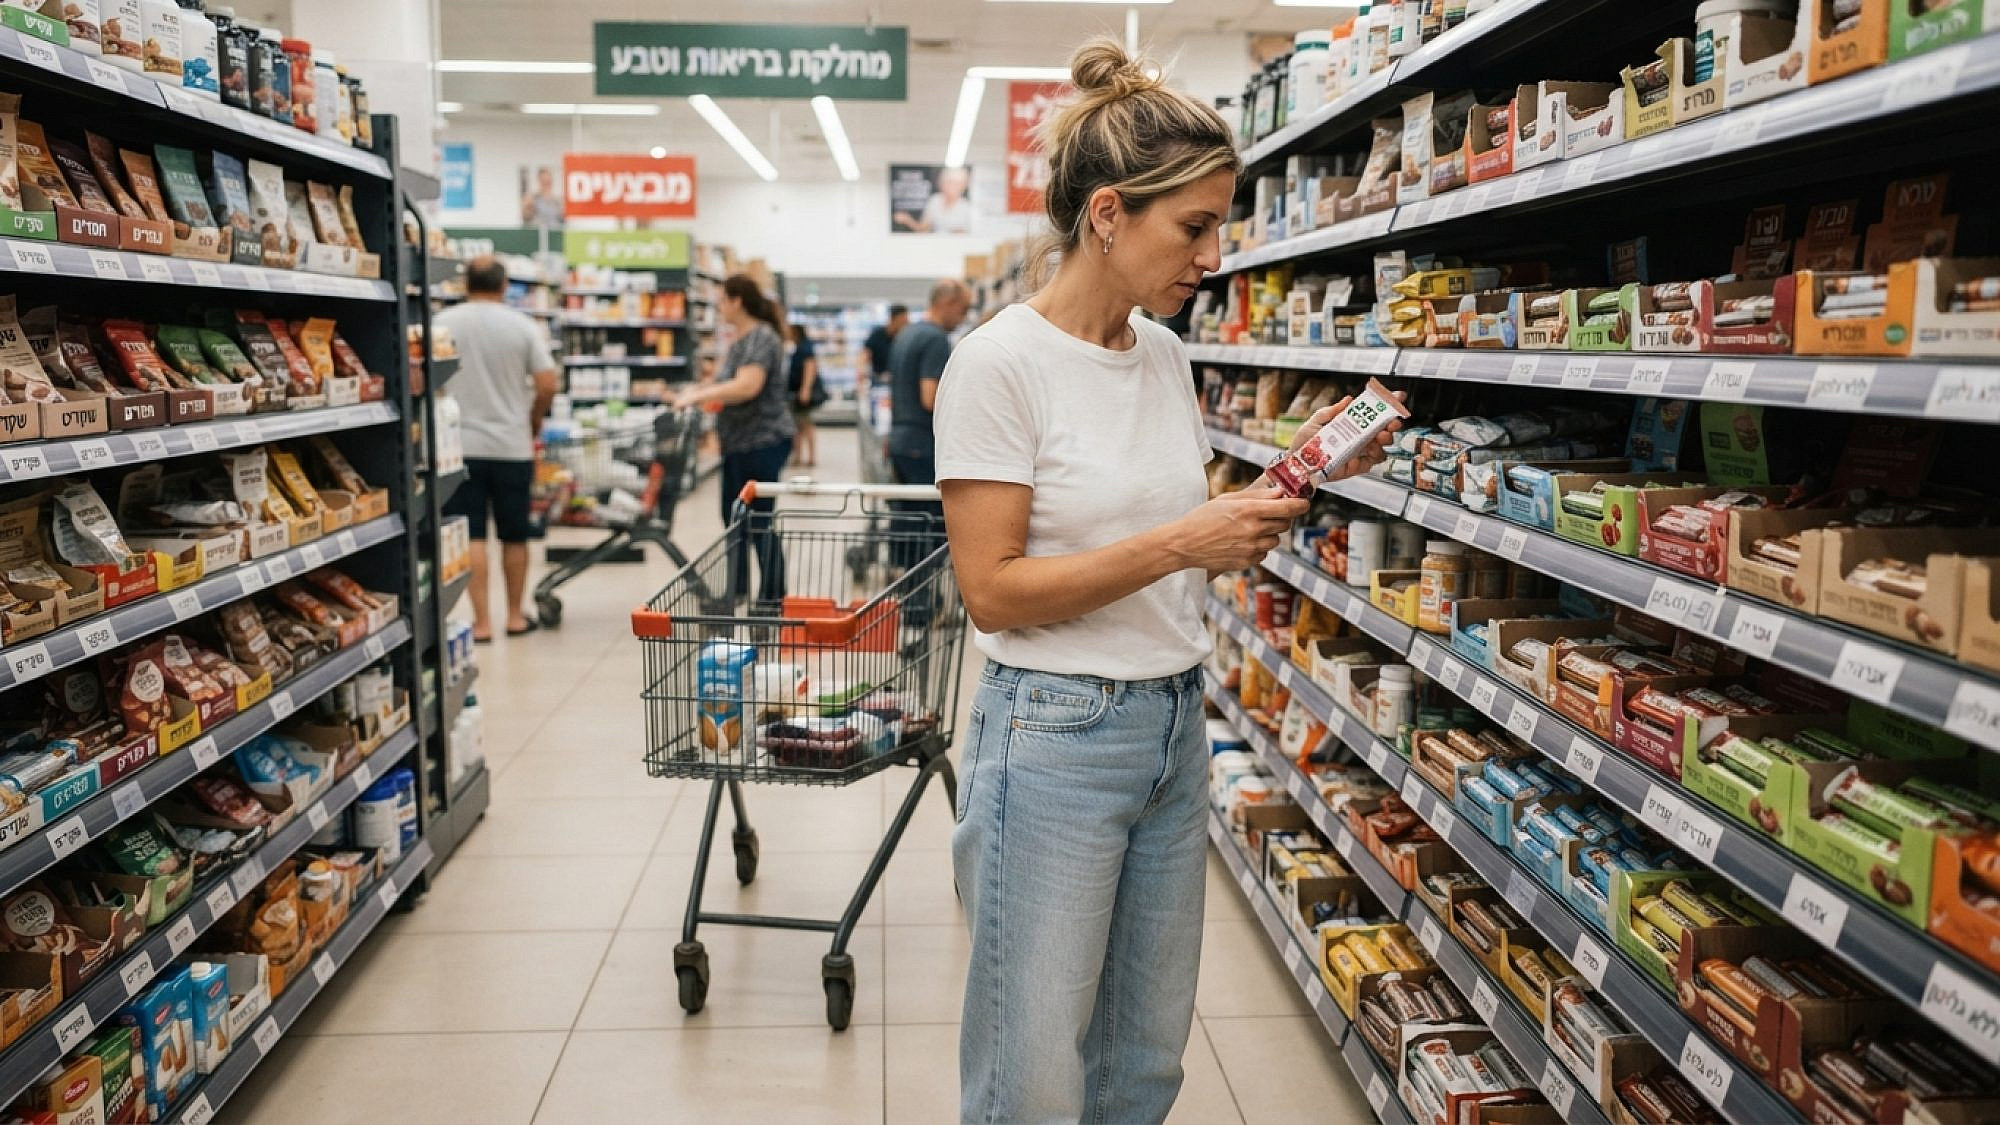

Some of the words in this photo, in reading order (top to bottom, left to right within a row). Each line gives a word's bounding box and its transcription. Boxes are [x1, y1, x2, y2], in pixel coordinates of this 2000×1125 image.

[610, 45, 681, 77] וטבע
[685, 46, 784, 77] בריאות
[788, 43, 892, 84] מחלקת
[566, 171, 692, 204] מבצעים
